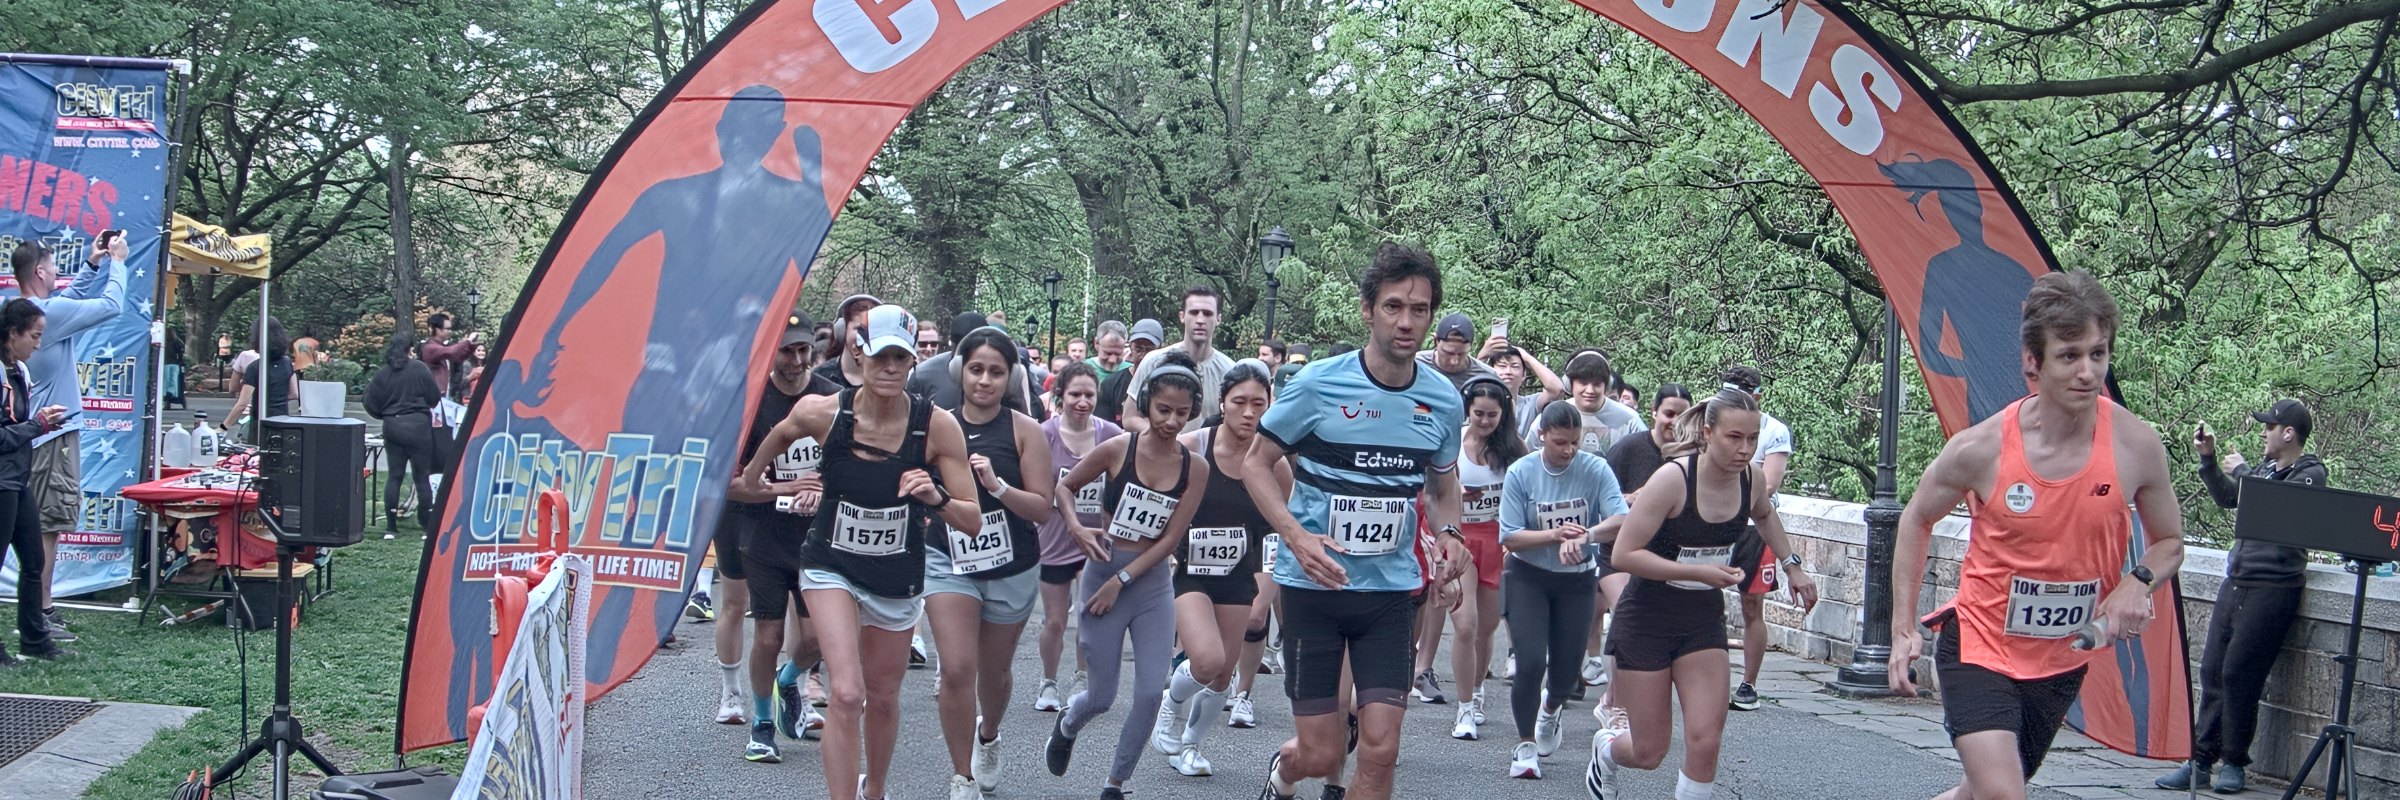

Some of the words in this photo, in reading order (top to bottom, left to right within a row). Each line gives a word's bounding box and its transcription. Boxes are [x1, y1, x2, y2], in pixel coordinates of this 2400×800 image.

[1366, 409, 1382, 418] TUI
[785, 446, 822, 464] 1418
[1354, 451, 1414, 470] Edwin
[469, 432, 710, 547] CityTri
[1074, 488, 1098, 500] 12
[1126, 486, 1145, 501] 10K
[840, 502, 860, 520] 10K
[888, 508, 907, 521] 10K
[1333, 498, 1357, 513] 10K
[1385, 500, 1406, 514] 10K
[985, 511, 1005, 525] 10K
[1127, 506, 1168, 530] 1415
[846, 526, 897, 546] 1575
[1192, 530, 1208, 540] 10K
[1342, 521, 1394, 543] 1424
[958, 531, 1002, 555] 1425
[1198, 545, 1238, 560] 1432
[469, 552, 496, 571] NOT
[511, 551, 539, 571] RAC
[597, 555, 631, 575] LIFE
[632, 556, 681, 581] TIME!
[2013, 579, 2041, 597] 10K
[2072, 580, 2098, 597] 10K
[2021, 604, 2084, 628] 1320
